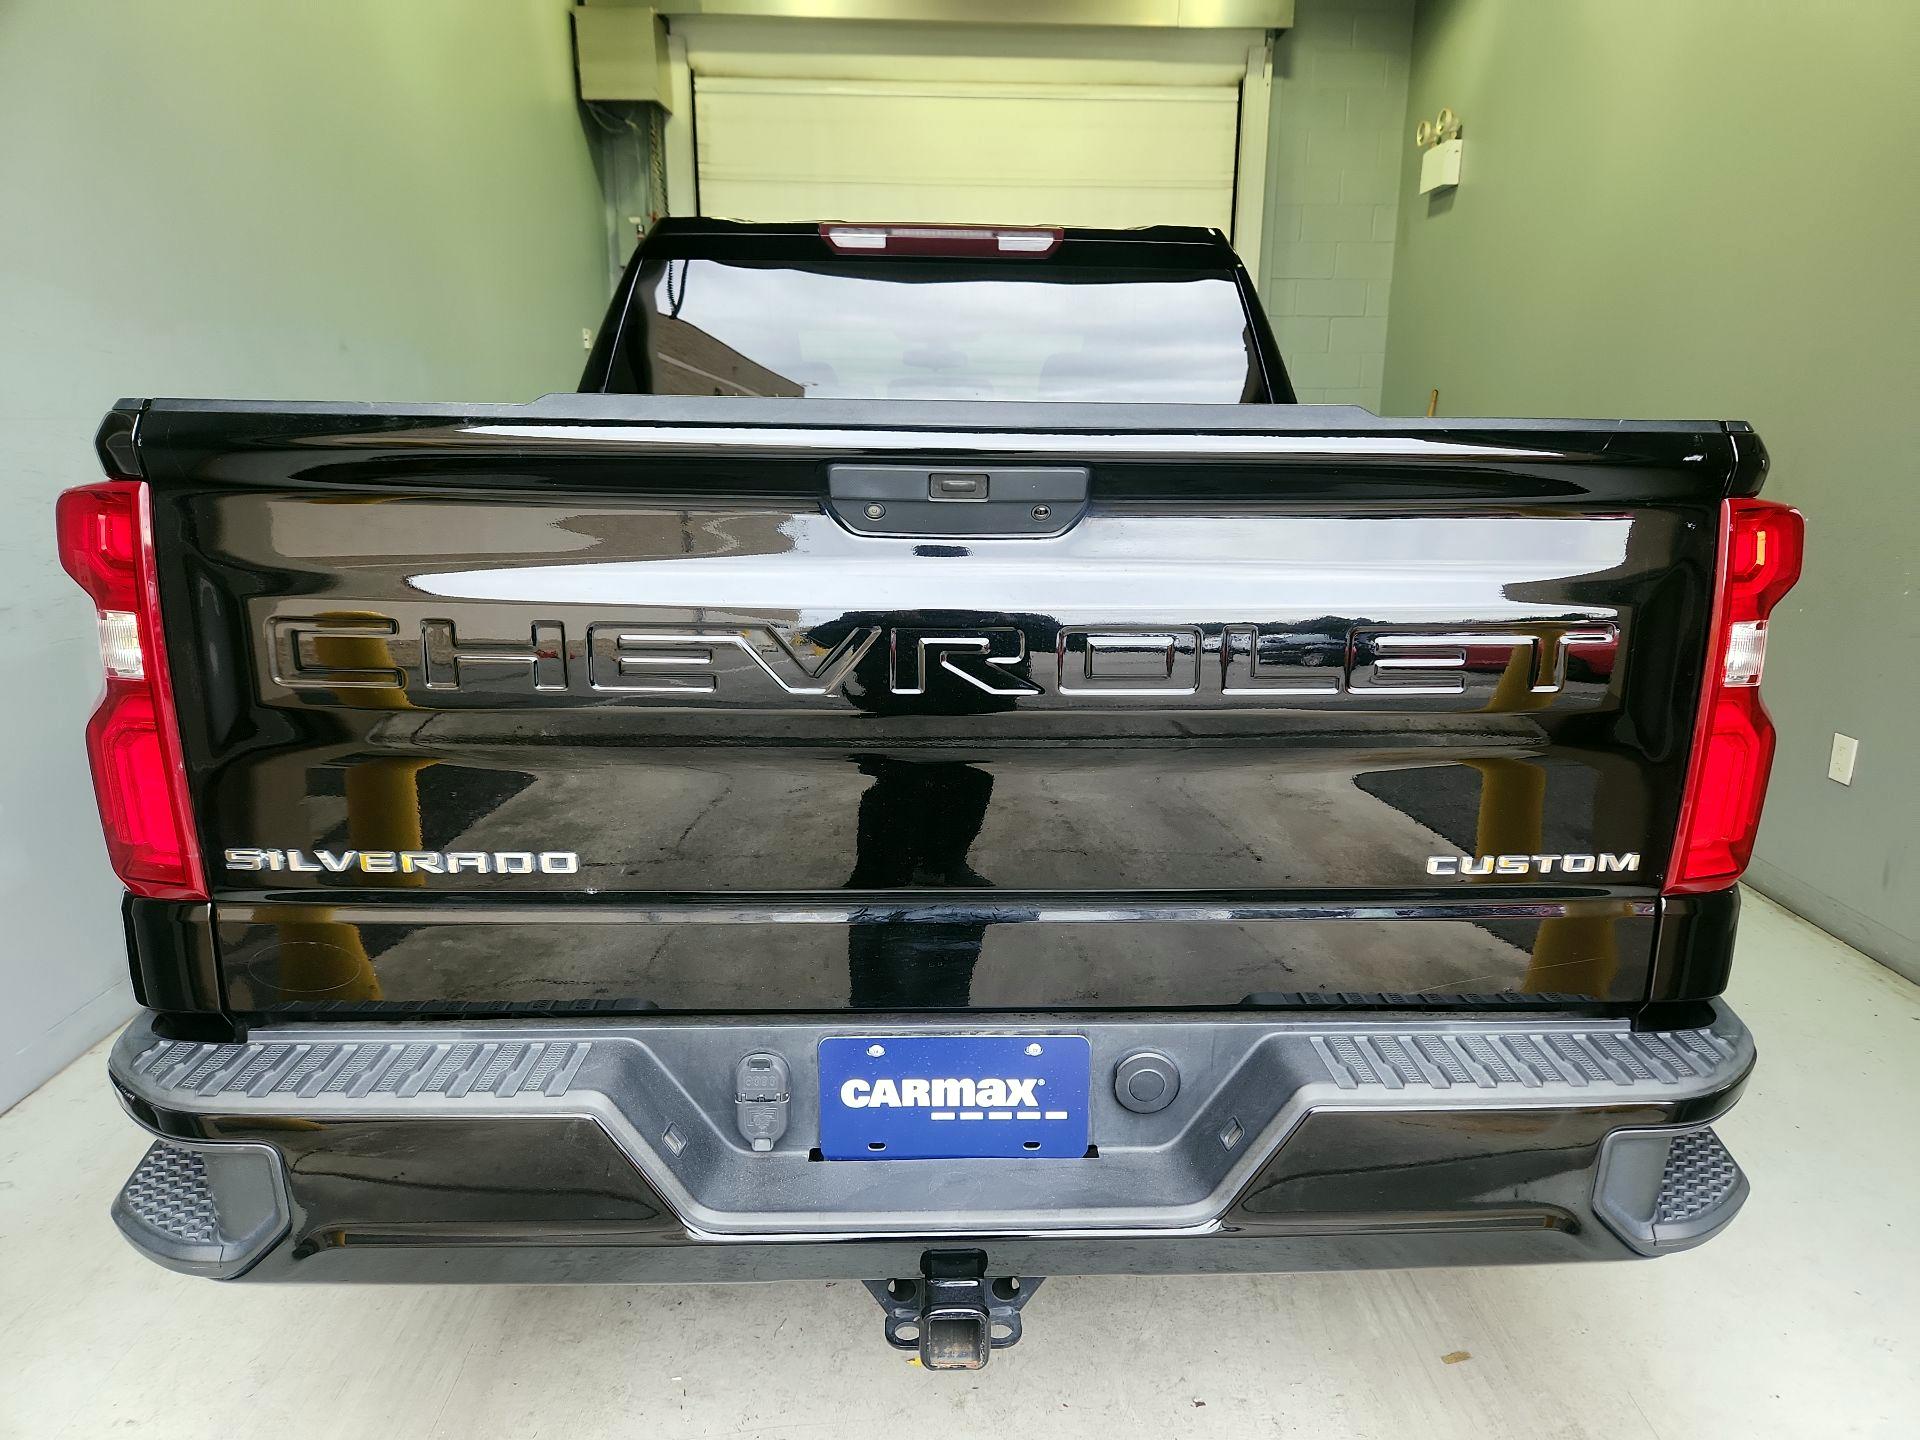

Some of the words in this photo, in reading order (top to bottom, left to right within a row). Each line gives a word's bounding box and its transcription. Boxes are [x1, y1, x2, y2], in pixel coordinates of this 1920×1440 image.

[263, 613, 1620, 697] CHEVROLET
[224, 848, 580, 875] SILVERADO
[1427, 852, 1641, 876] CUSTOM
